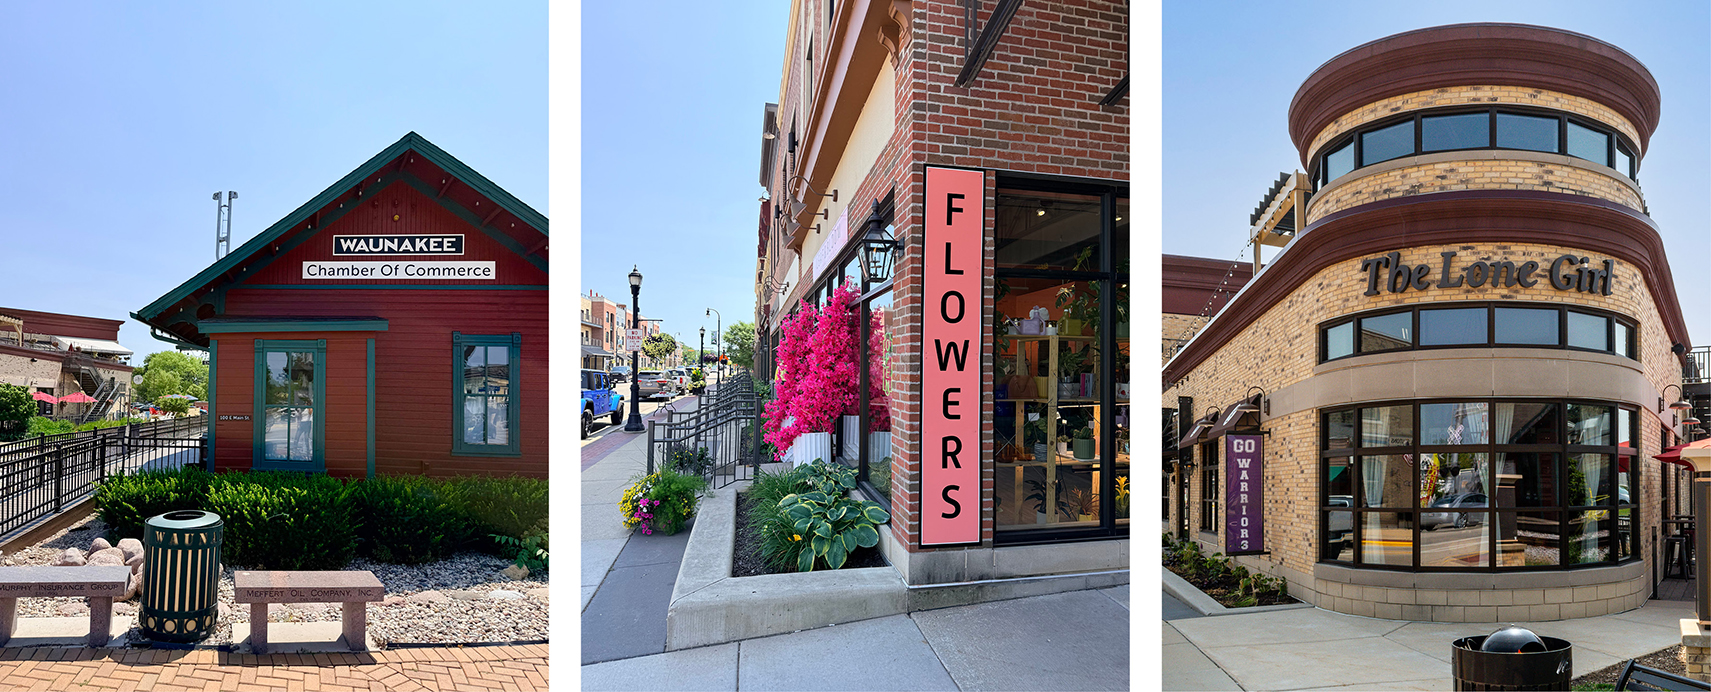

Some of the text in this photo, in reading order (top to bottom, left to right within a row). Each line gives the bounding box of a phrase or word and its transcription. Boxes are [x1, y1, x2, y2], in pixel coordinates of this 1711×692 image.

[340, 238, 456, 252] WAUNAKEE
[307, 264, 491, 276] Chamber Of Commerce
[1361, 251, 1615, 297] The Lone Girl
[934, 192, 970, 519] FLOWERS
[1233, 439, 1255, 453] GO
[246, 590, 285, 598] MEFFERT
[290, 589, 305, 597] OIL
[358, 589, 374, 597] INC.
